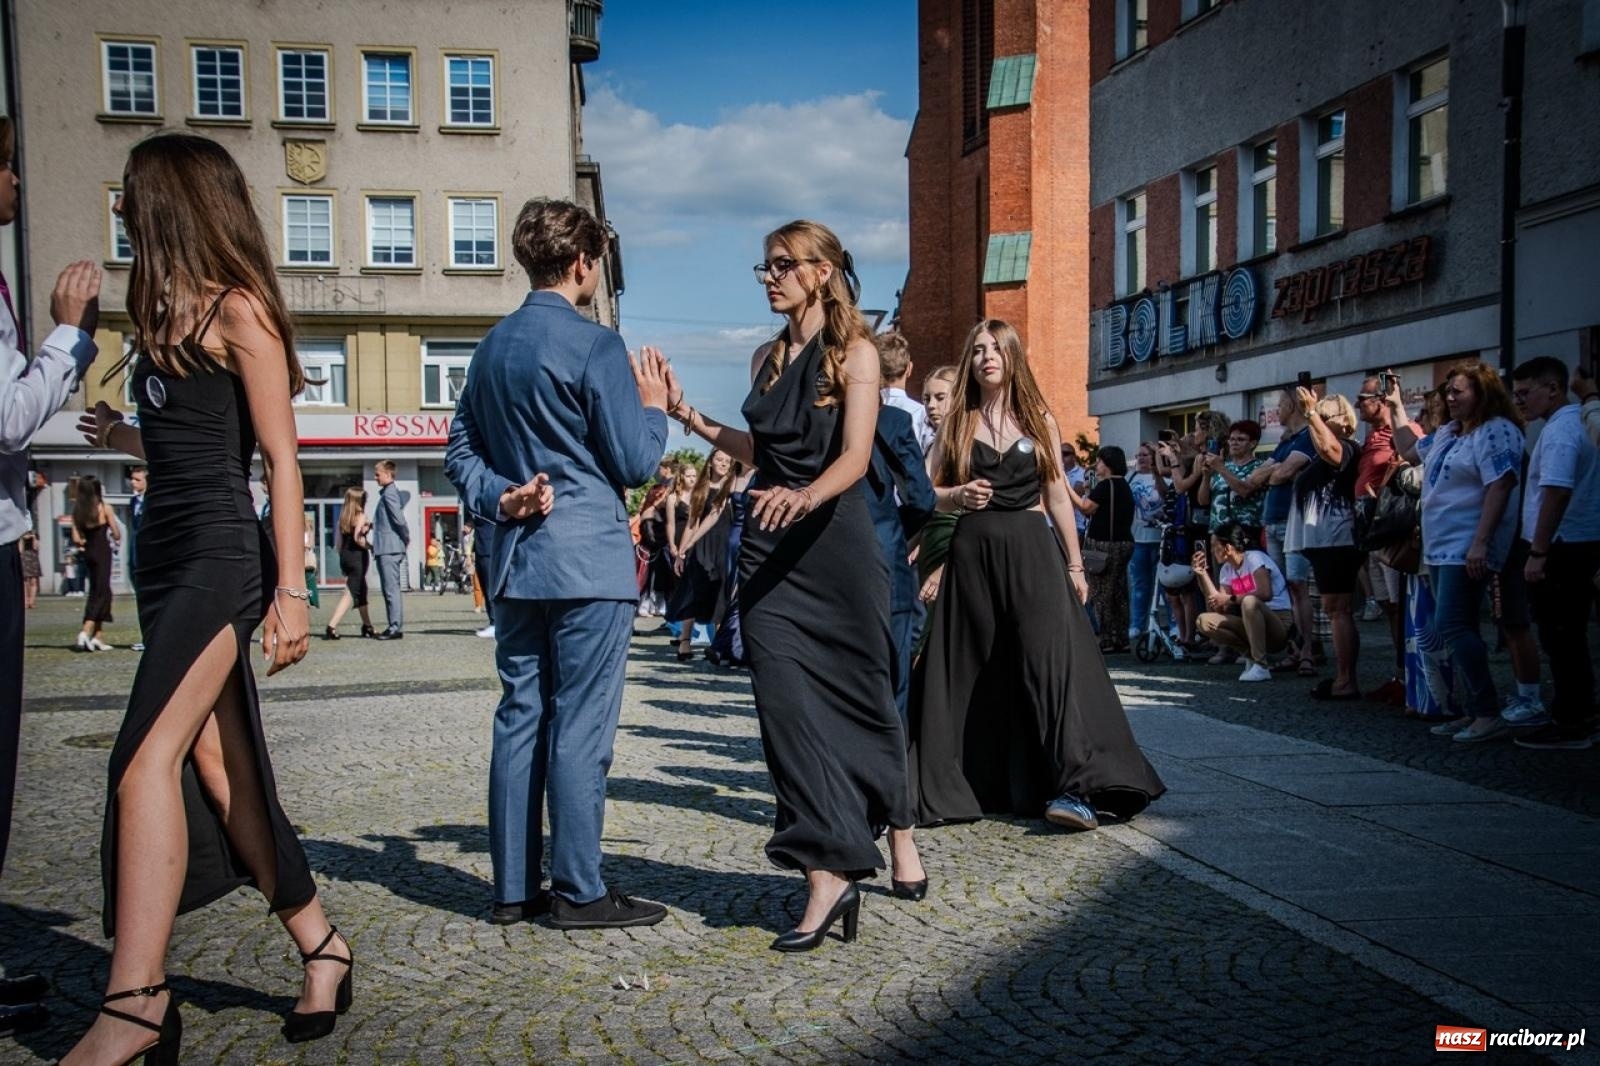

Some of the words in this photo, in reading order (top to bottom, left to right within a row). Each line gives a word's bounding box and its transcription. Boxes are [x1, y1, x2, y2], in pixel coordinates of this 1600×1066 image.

[1101, 267, 1257, 371] BOLKO
[1271, 235, 1431, 324] zaprasza
[354, 415, 449, 436] ROSSM
